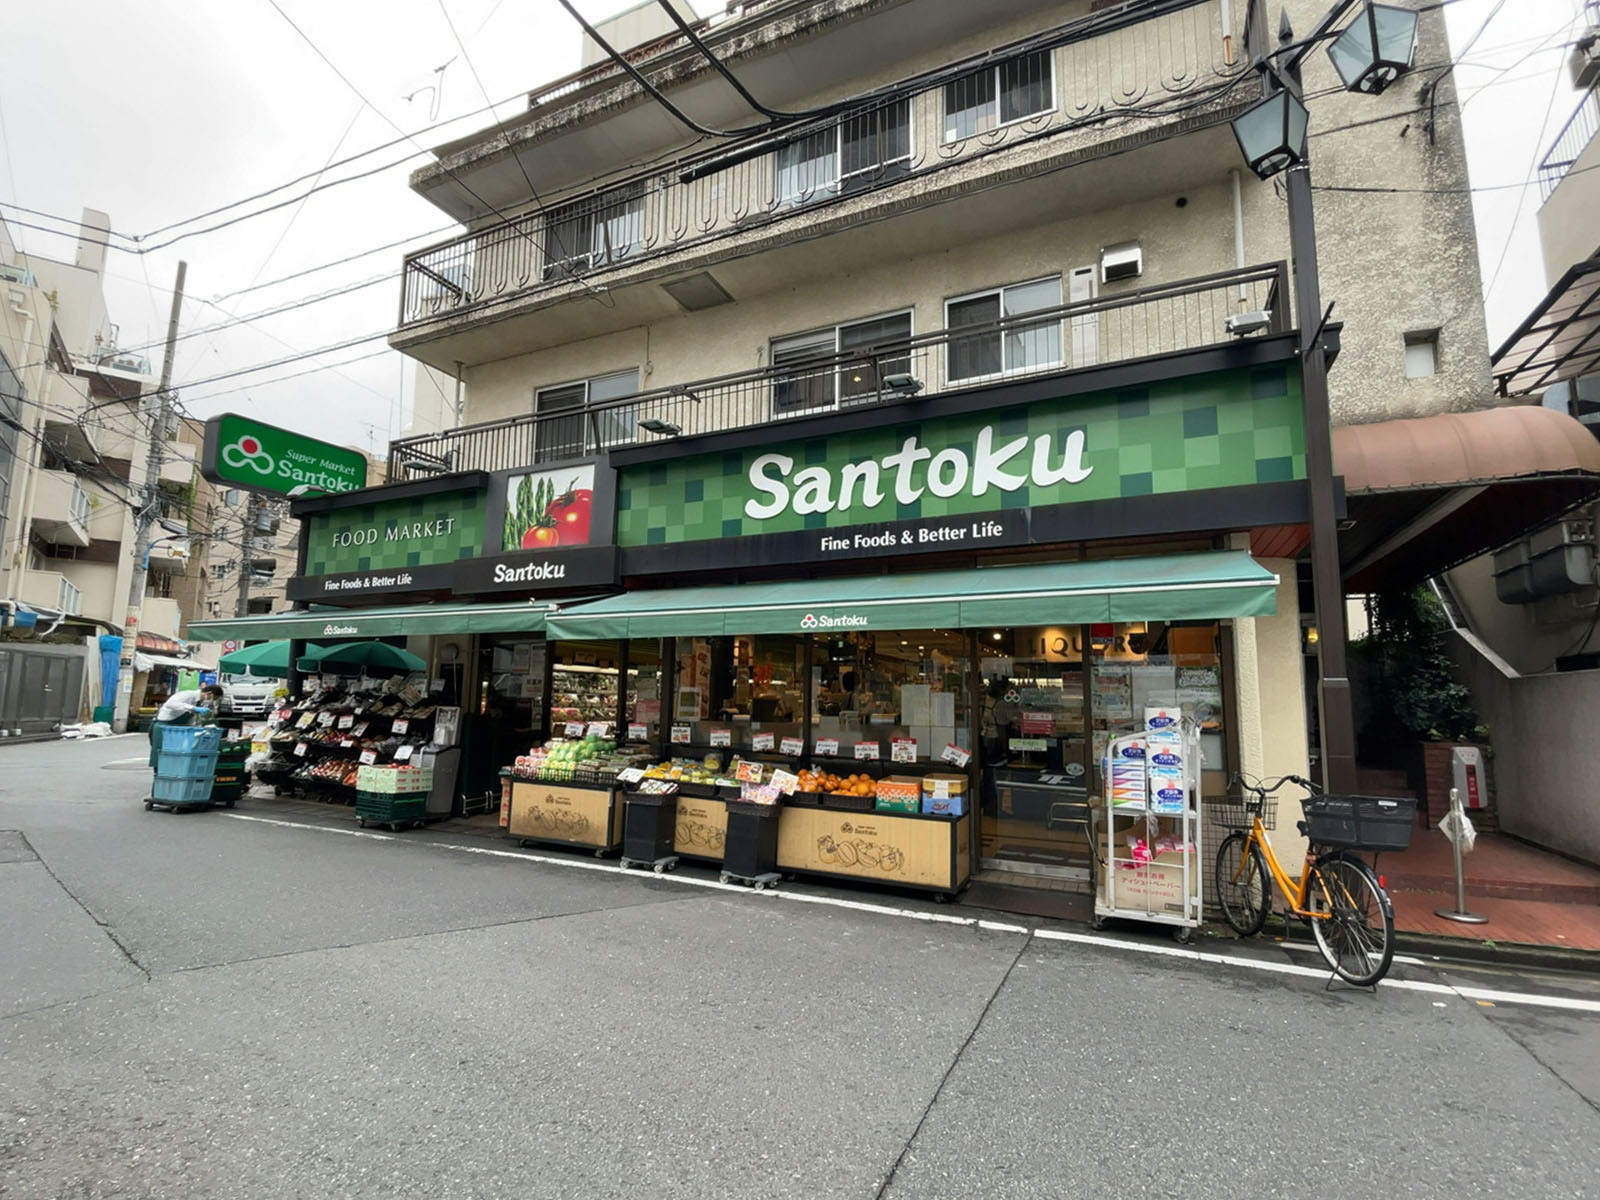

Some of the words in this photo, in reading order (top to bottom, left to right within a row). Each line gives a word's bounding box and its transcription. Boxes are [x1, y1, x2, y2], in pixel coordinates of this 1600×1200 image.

[285, 449, 317, 465] Super
[320, 459, 356, 476] Market
[743, 425, 1094, 520] Santoku
[332, 528, 378, 548] FOOD
[385, 518, 455, 541] MARKET
[821, 536, 850, 551] Fine
[854, 531, 897, 549] Foods
[901, 529, 914, 545] &
[918, 525, 967, 543] Better
[972, 520, 1003, 539] Life
[324, 580, 340, 591] Fine
[341, 577, 362, 589] Foods
[363, 577, 370, 588] &
[372, 575, 396, 587] Better
[397, 573, 413, 585] Life
[493, 561, 566, 583] Santoku
[818, 615, 868, 628] Santoku
[1027, 636, 1127, 657] LIQUR
